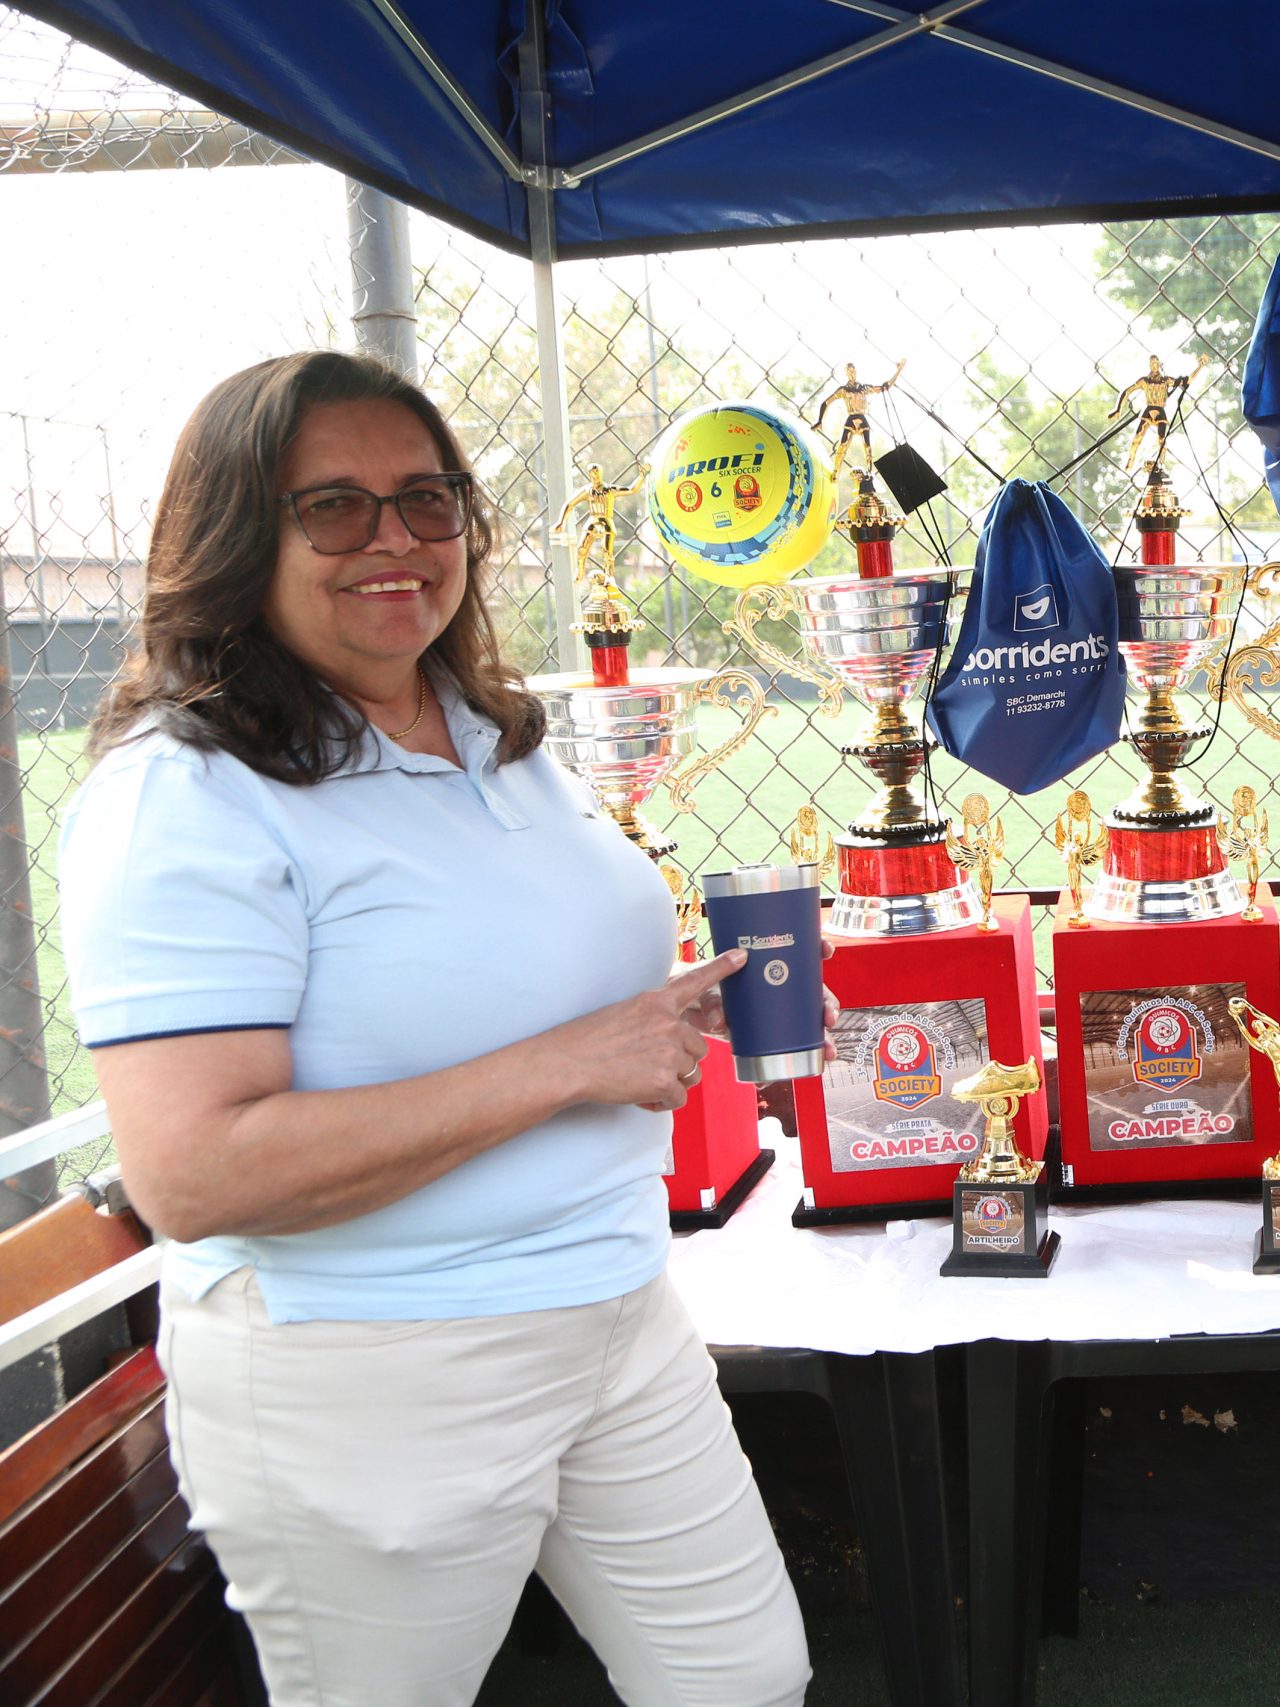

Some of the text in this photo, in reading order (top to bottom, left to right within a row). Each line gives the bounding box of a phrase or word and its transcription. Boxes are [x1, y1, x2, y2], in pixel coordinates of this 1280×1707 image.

[733, 466, 762, 475] SOCCER
[711, 482, 722, 498] 6
[962, 674, 1016, 687] simples
[1026, 670, 1062, 682] como
[1006, 690, 1066, 707] SBC Demarchi
[1006, 700, 1066, 717] 11 93232-8778
[1117, 1025, 1129, 1048] Copa
[1163, 996, 1175, 1004] do
[1176, 999, 1198, 1014] ABC
[1194, 1010, 1206, 1022] de
[1202, 1021, 1215, 1054] Society
[855, 1042, 866, 1066] Copa
[900, 1012, 912, 1020] do
[914, 1014, 936, 1030] ABC
[932, 1026, 944, 1038] de
[942, 1037, 955, 1071] Society
[1140, 1062, 1194, 1076] SOCIETY
[880, 1080, 936, 1094] SOCIETY
[911, 1120, 932, 1129] PRATA
[1110, 1112, 1233, 1139] CAMPEÃO
[852, 1131, 978, 1160] CAMPEÃO
[968, 1236, 1018, 1244] ARTILHEIRO
